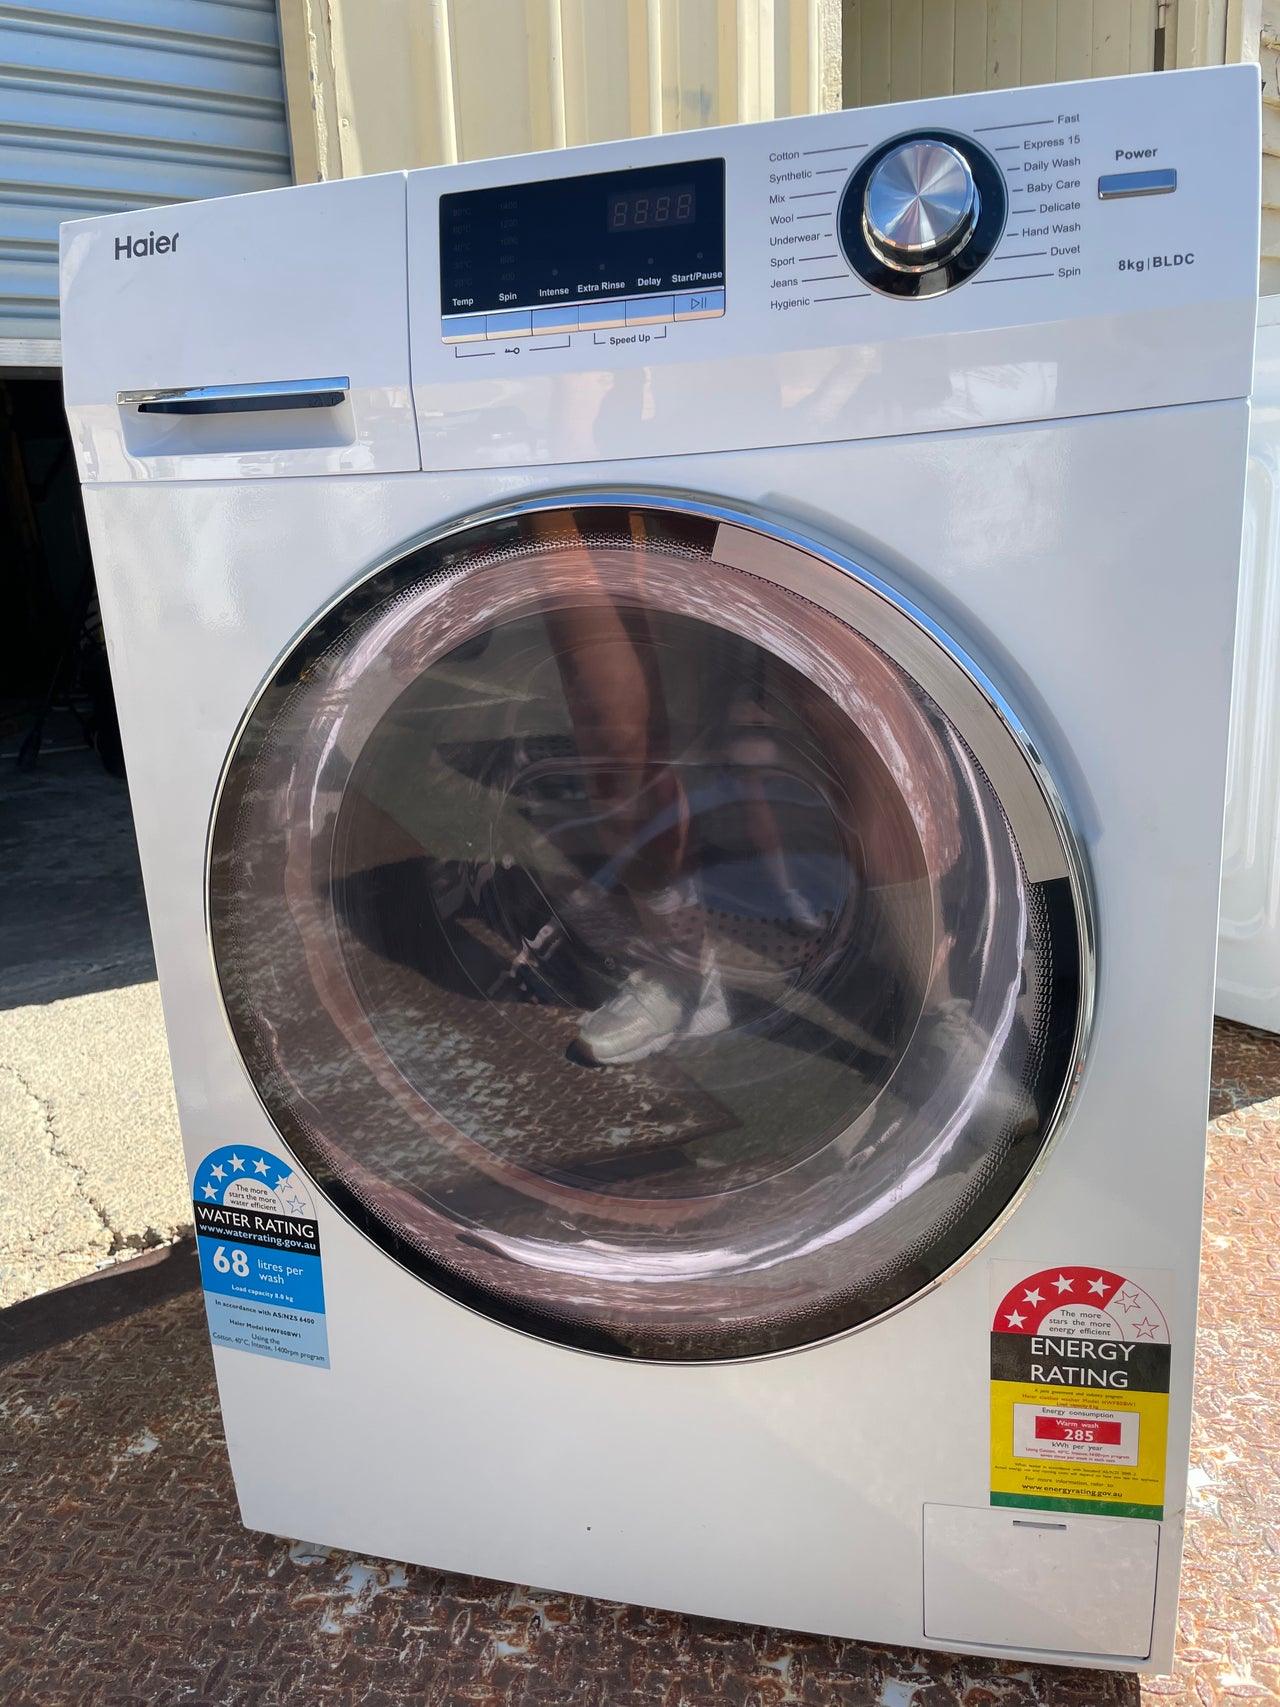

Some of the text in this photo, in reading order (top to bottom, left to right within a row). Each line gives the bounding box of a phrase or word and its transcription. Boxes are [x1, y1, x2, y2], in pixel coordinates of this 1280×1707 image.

[1057, 113, 1080, 124] Fast
[1023, 134, 1081, 150] Express 15
[769, 151, 800, 162] Cotton
[1115, 148, 1158, 161] Power
[1024, 156, 1081, 172] Daily Wash
[769, 169, 812, 184] Synthetic
[1027, 179, 1081, 193] Baby Care
[769, 194, 786, 204] Mix
[1040, 201, 1081, 214] Delicate
[770, 214, 794, 225] Wool
[1022, 222, 1081, 237] Hand Wash
[115, 230, 179, 260] Haier
[769, 233, 820, 246] Underwear
[1050, 244, 1080, 256] Duvet
[770, 256, 795, 268] Sport
[671, 271, 723, 283] Start/Pause
[1058, 266, 1081, 278] Spin
[577, 281, 626, 293] Extra Rinse
[637, 277, 661, 287] Delay
[770, 278, 798, 288] Jeans
[499, 292, 517, 303] Spin
[539, 287, 570, 297] Intense
[452, 298, 474, 307] Temp
[770, 297, 810, 311] Hygienic
[609, 334, 651, 346] Speed Up
[229, 1191, 245, 1199] stars
[246, 1193, 257, 1201] the
[235, 1184, 268, 1196] The more
[229, 1199, 277, 1212] water efficient
[197, 1206, 315, 1239] WATER RATING
[199, 1224, 316, 1250] www.waterrating.gov.au
[213, 1246, 250, 1277] 68
[257, 1258, 304, 1277] litres per
[258, 1272, 285, 1285] wash
[231, 1284, 247, 1293] Load
[248, 1288, 274, 1299] capacity
[285, 1294, 294, 1303] kg
[222, 1302, 257, 1313] accordance
[258, 1308, 272, 1317] with
[1060, 1309, 1076, 1318] The
[229, 1318, 245, 1328] Haier
[246, 1322, 264, 1331] Model
[1072, 1319, 1086, 1327] the
[1049, 1326, 1111, 1336] energy efficient
[251, 1333, 280, 1345] Using the
[1031, 1337, 1136, 1361] ENERGY
[300, 1352, 325, 1361] program
[1031, 1364, 1128, 1388] RATING
[1042, 1407, 1114, 1419] Energy consumption
[1056, 1419, 1099, 1429] Warm wash
[1064, 1428, 1094, 1442] 285
[1052, 1441, 1069, 1449] kWh
[1072, 1443, 1084, 1451] per
[1021, 1483, 1123, 1498] www.energyrating.gov.au
